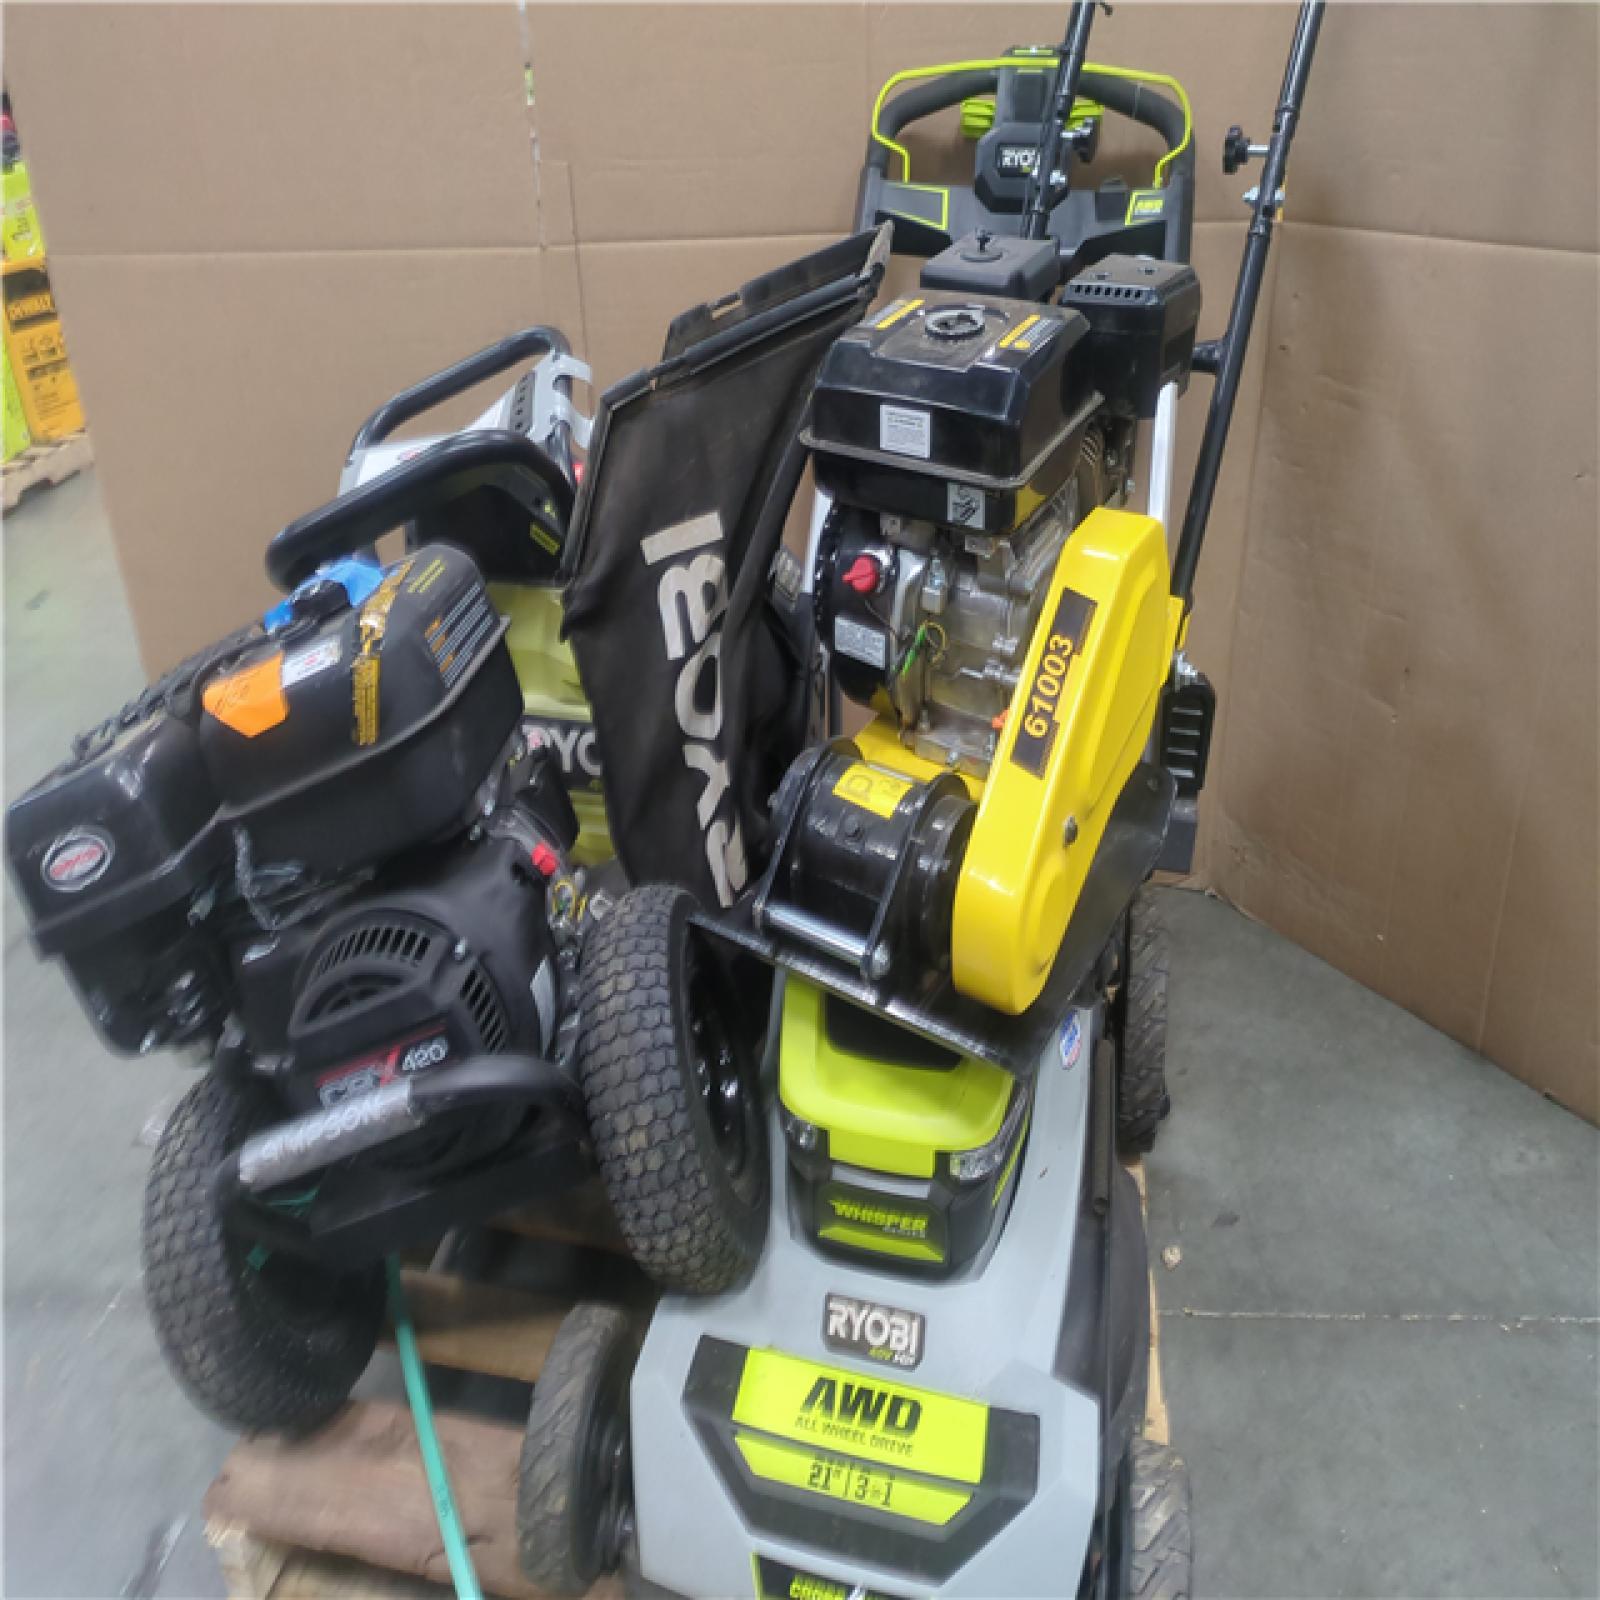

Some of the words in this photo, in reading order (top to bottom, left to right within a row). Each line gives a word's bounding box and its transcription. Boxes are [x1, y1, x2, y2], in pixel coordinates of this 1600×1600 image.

[1024, 634, 1073, 738] 61003
[828, 1298, 919, 1356] RYOBI
[795, 1415, 818, 1433] ALL
[800, 1375, 923, 1436] AWD
